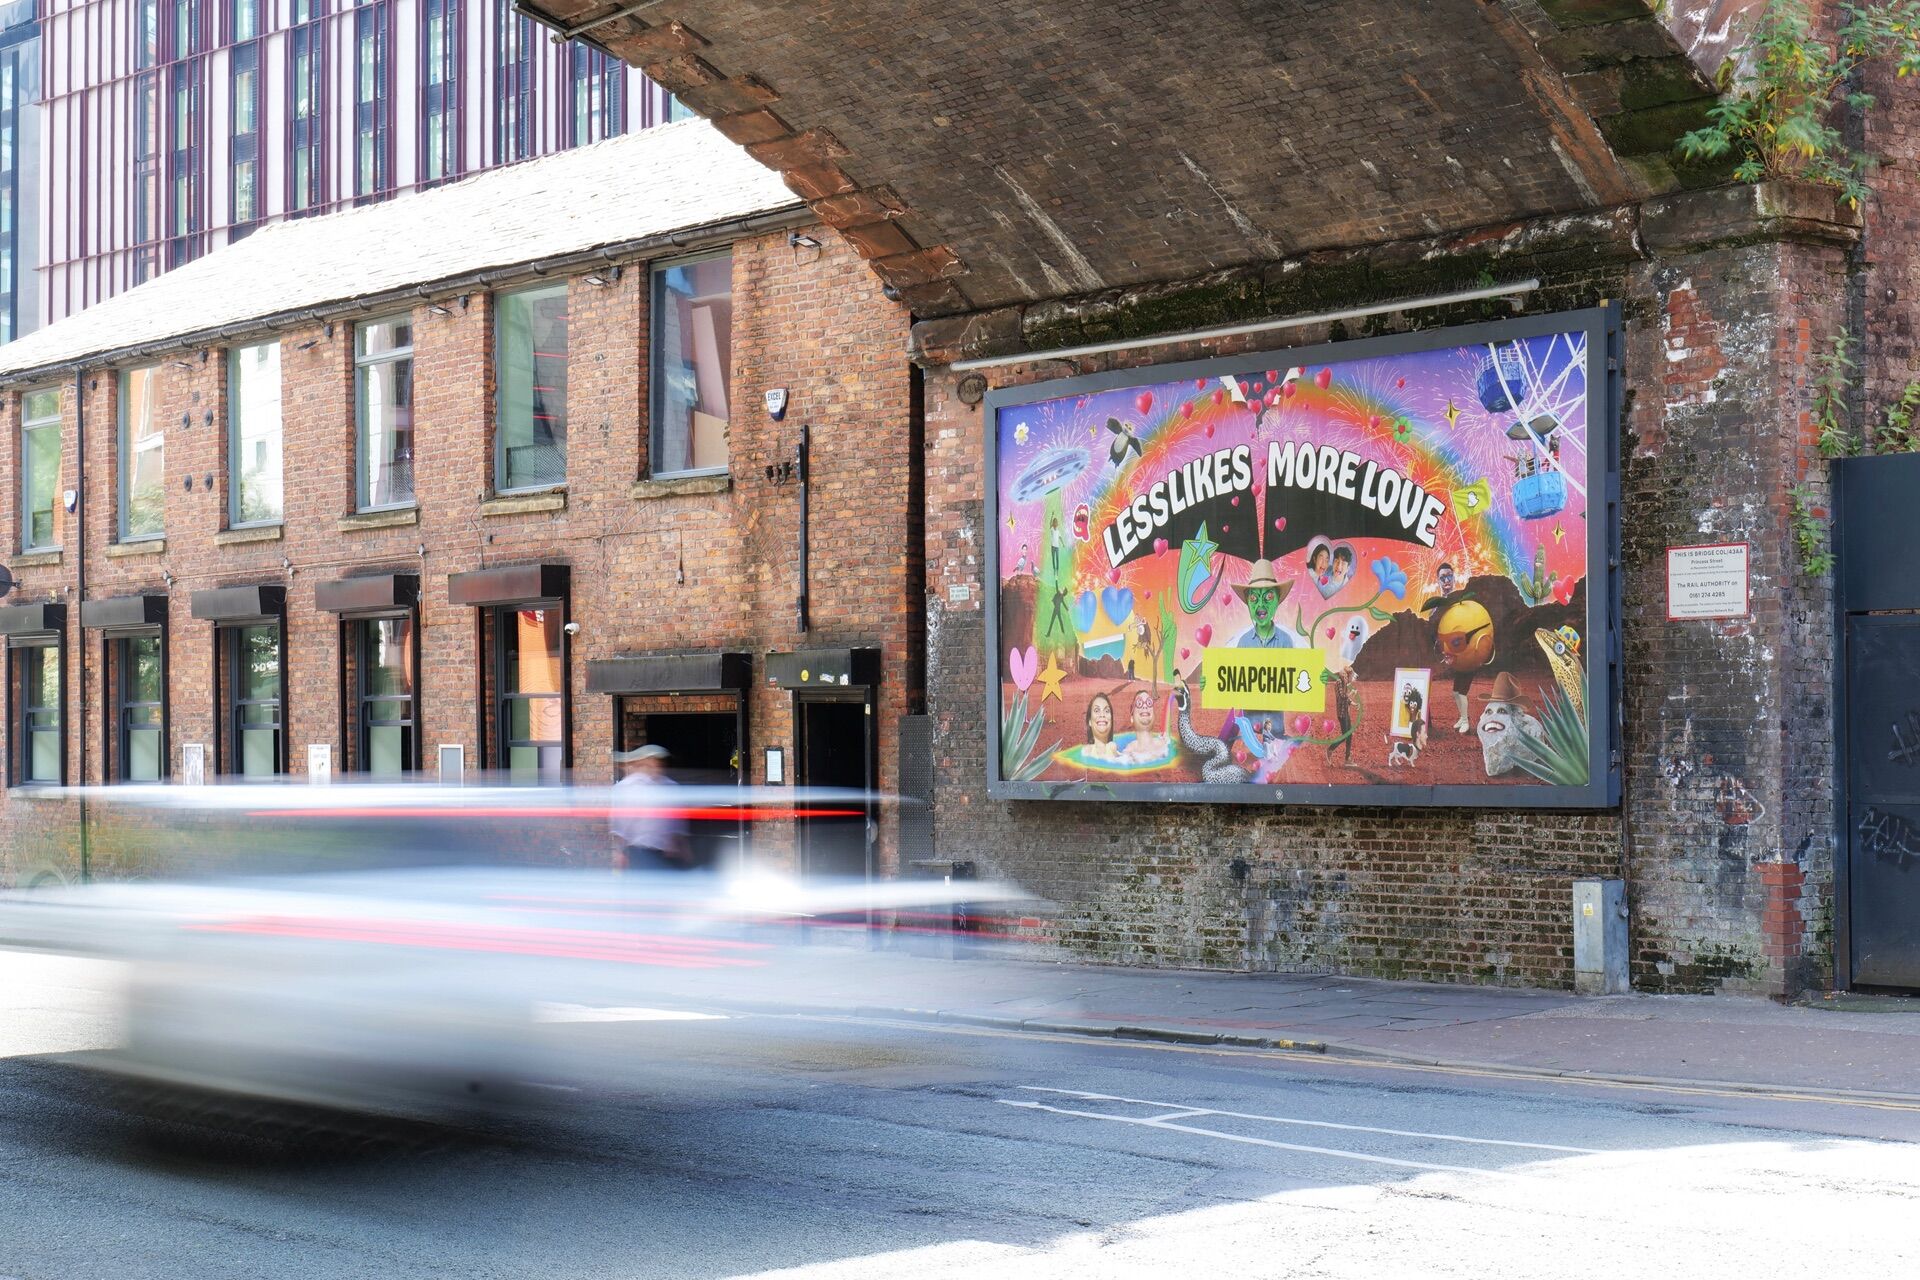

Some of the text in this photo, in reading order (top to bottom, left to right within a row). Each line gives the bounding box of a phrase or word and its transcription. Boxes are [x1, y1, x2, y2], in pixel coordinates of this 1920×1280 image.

[1103, 441, 1445, 568] LESS LIKES MORE LOVE
[1694, 549, 1715, 557] BRIDGE
[1217, 665, 1296, 693] SNAPCHAT
